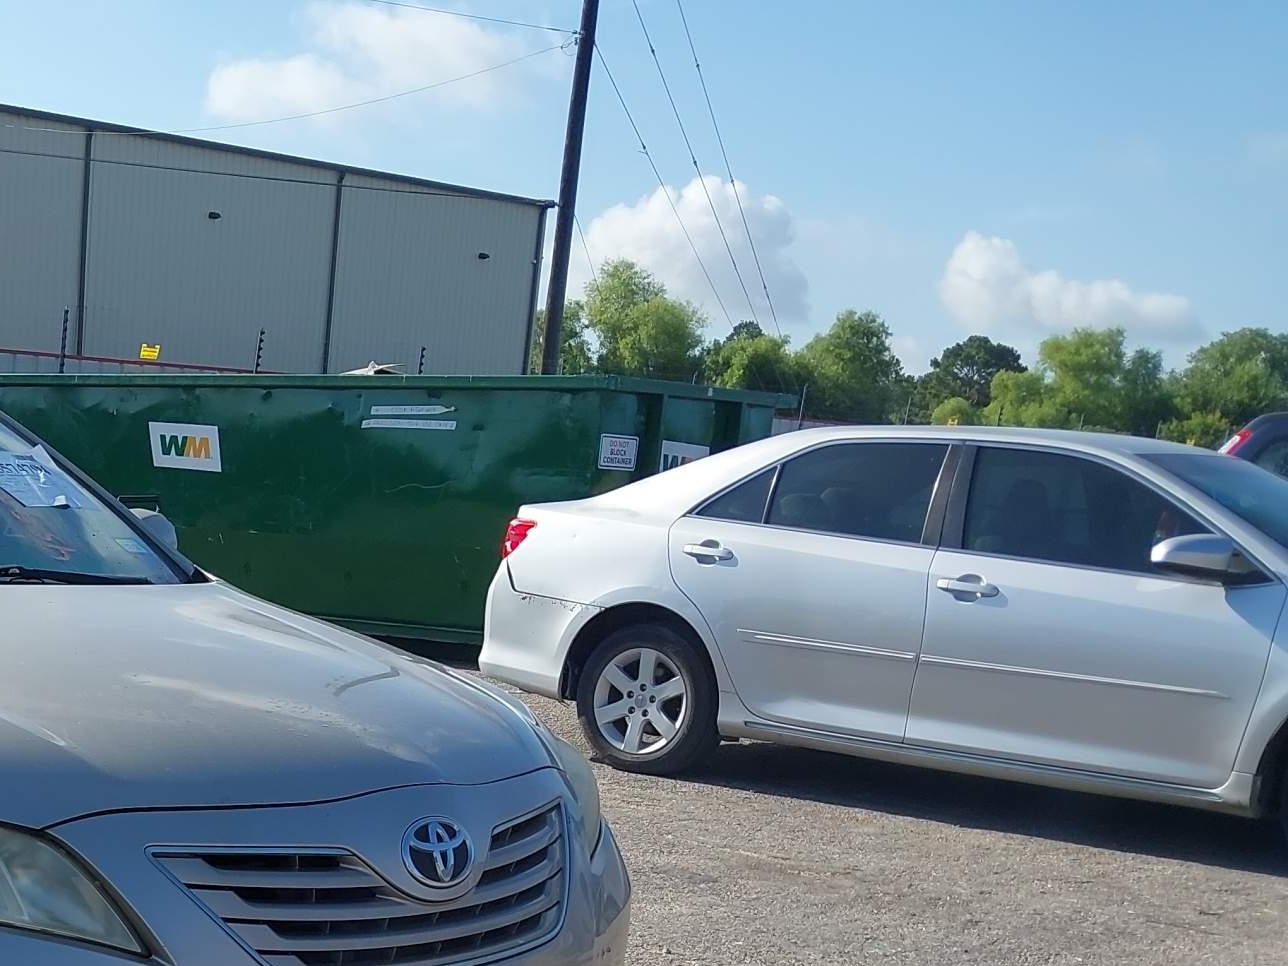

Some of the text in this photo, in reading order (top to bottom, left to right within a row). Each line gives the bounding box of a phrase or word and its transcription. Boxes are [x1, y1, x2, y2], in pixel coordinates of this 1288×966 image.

[160, 433, 211, 459] WM
[609, 439, 630, 448] DO NOT
[609, 448, 627, 456] BLOCK
[603, 456, 632, 465] CONTAINER
